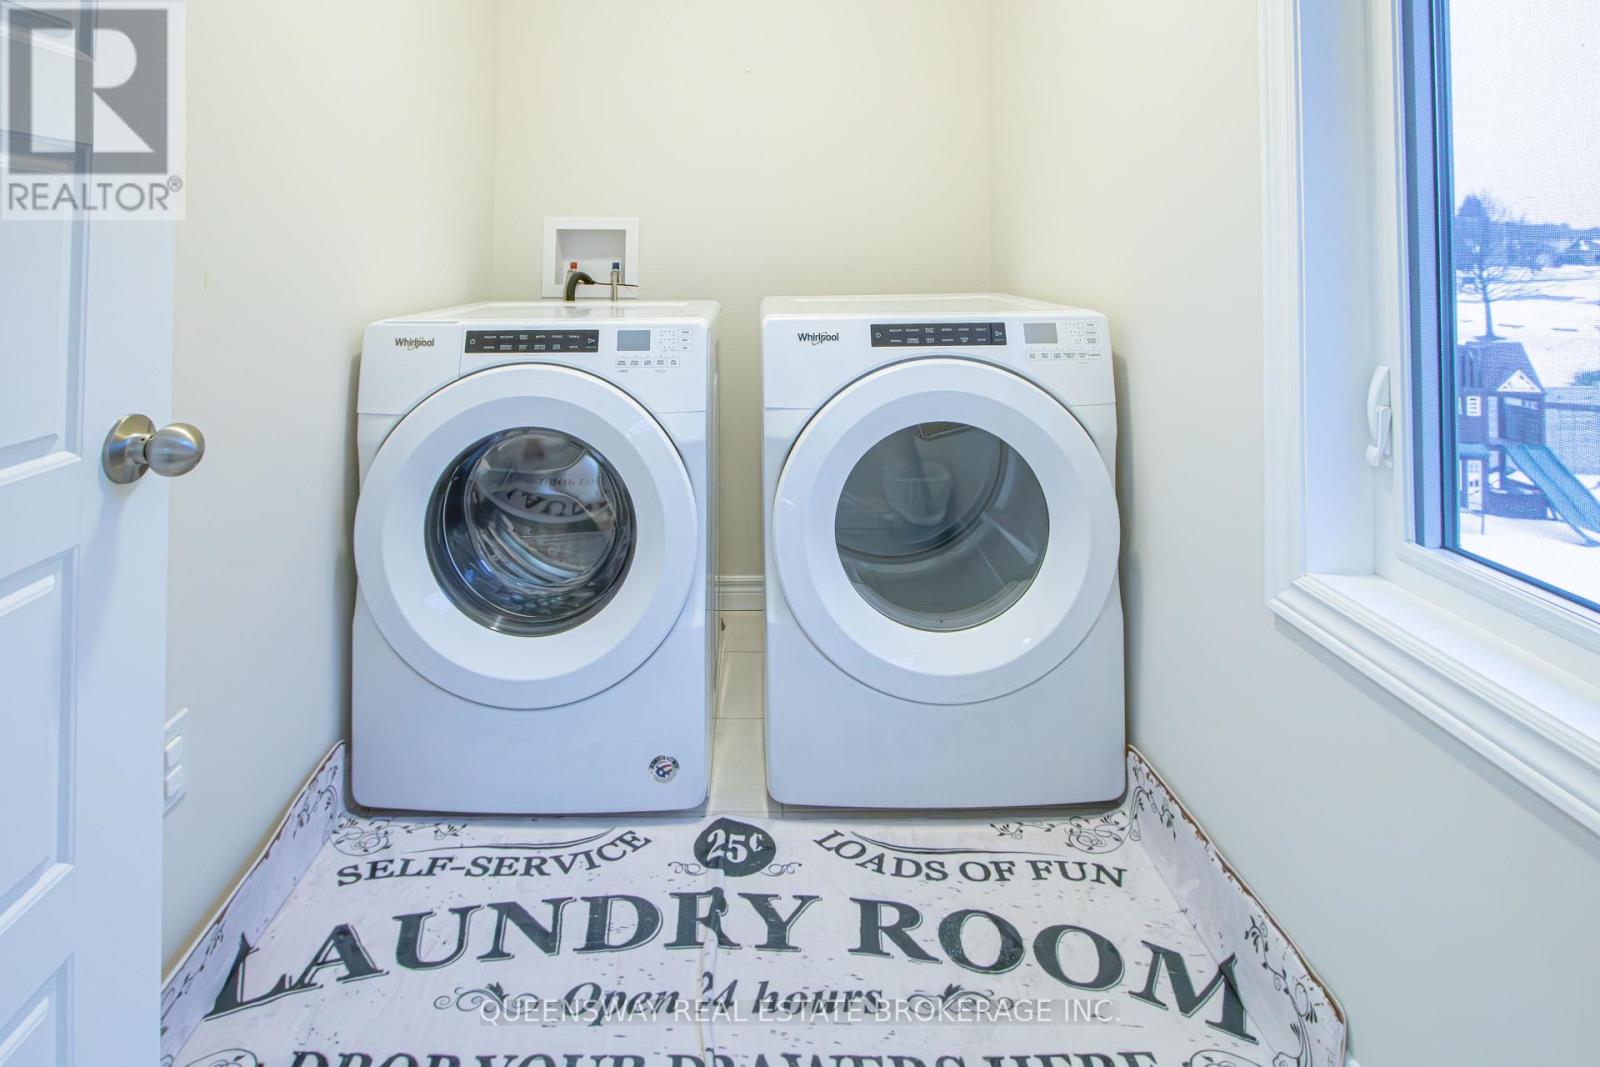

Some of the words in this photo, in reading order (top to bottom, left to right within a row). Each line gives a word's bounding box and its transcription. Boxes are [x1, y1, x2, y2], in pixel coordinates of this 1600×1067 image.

[395, 337, 435, 351] Whirlpool
[797, 331, 839, 345] Whirlpool
[337, 830, 652, 887] SELF-SERVICE
[812, 830, 949, 882] LOADS
[960, 860, 1017, 883] OF
[1031, 860, 1128, 888] FUN
[203, 886, 823, 1022] LAUNDRY
[848, 897, 1259, 1045] ROOM
[562, 981, 680, 1028] Open
[752, 980, 883, 1015] hours
